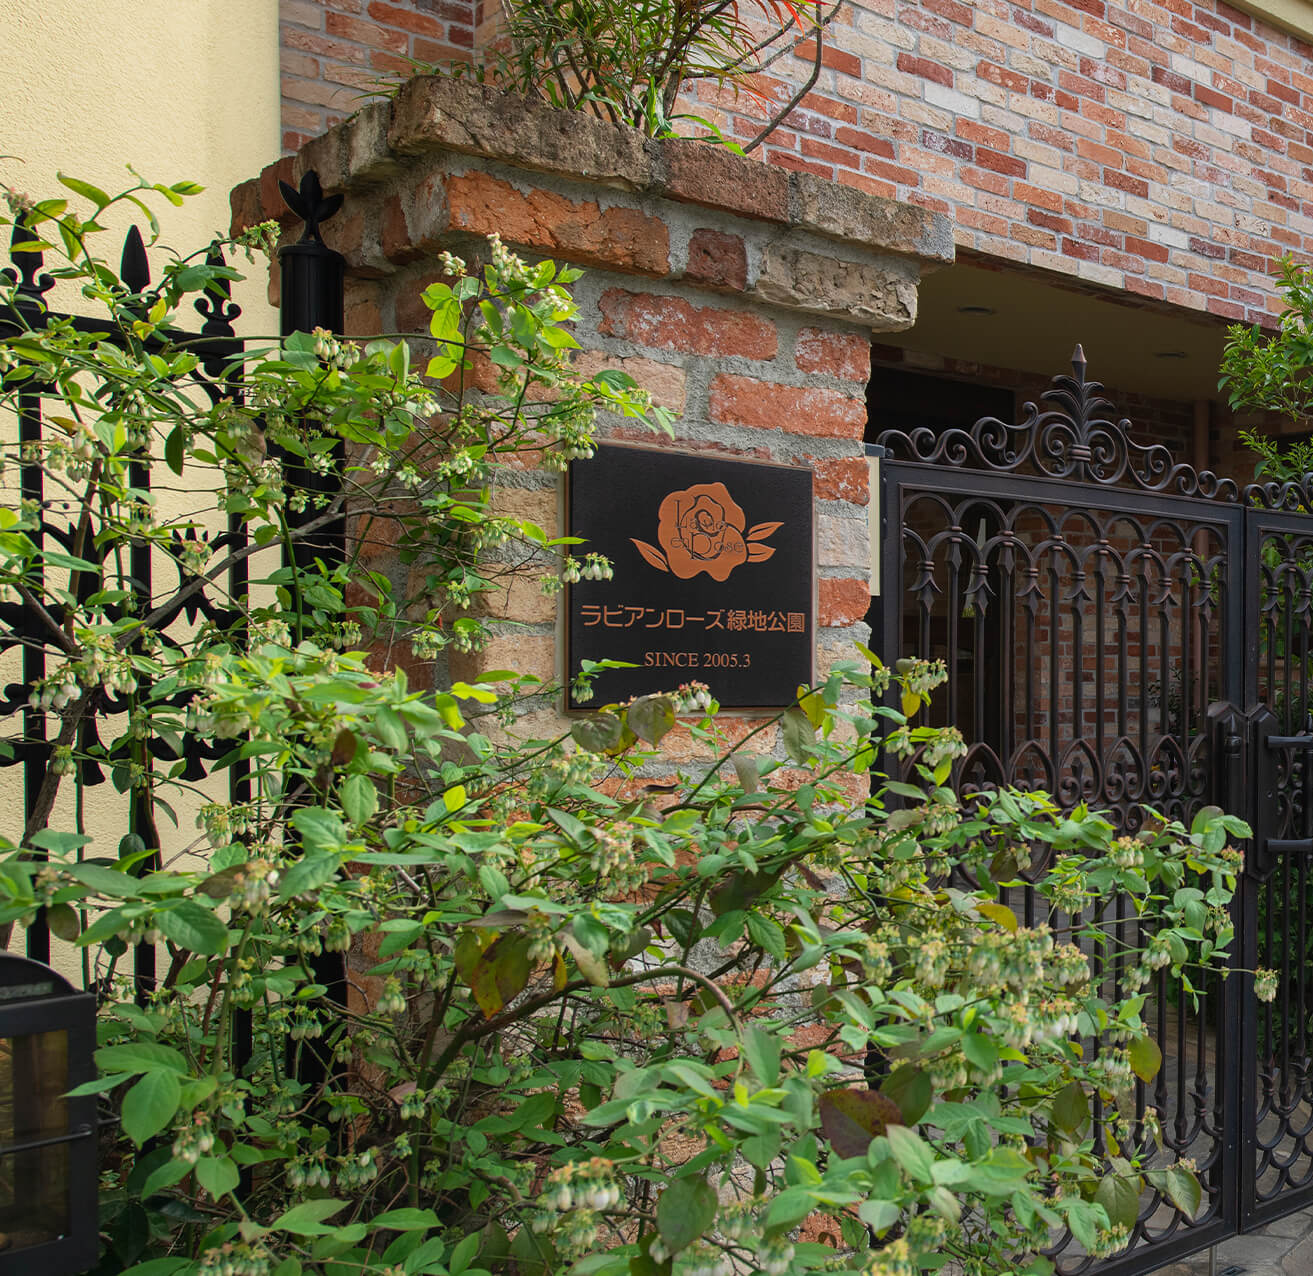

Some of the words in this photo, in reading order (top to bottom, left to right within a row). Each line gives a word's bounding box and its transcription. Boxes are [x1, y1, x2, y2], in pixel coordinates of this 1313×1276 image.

[580, 604, 806, 633] ラビアンローズ緑地公園
[644, 652, 699, 667] SINCE
[703, 653, 752, 668] 2005.3
